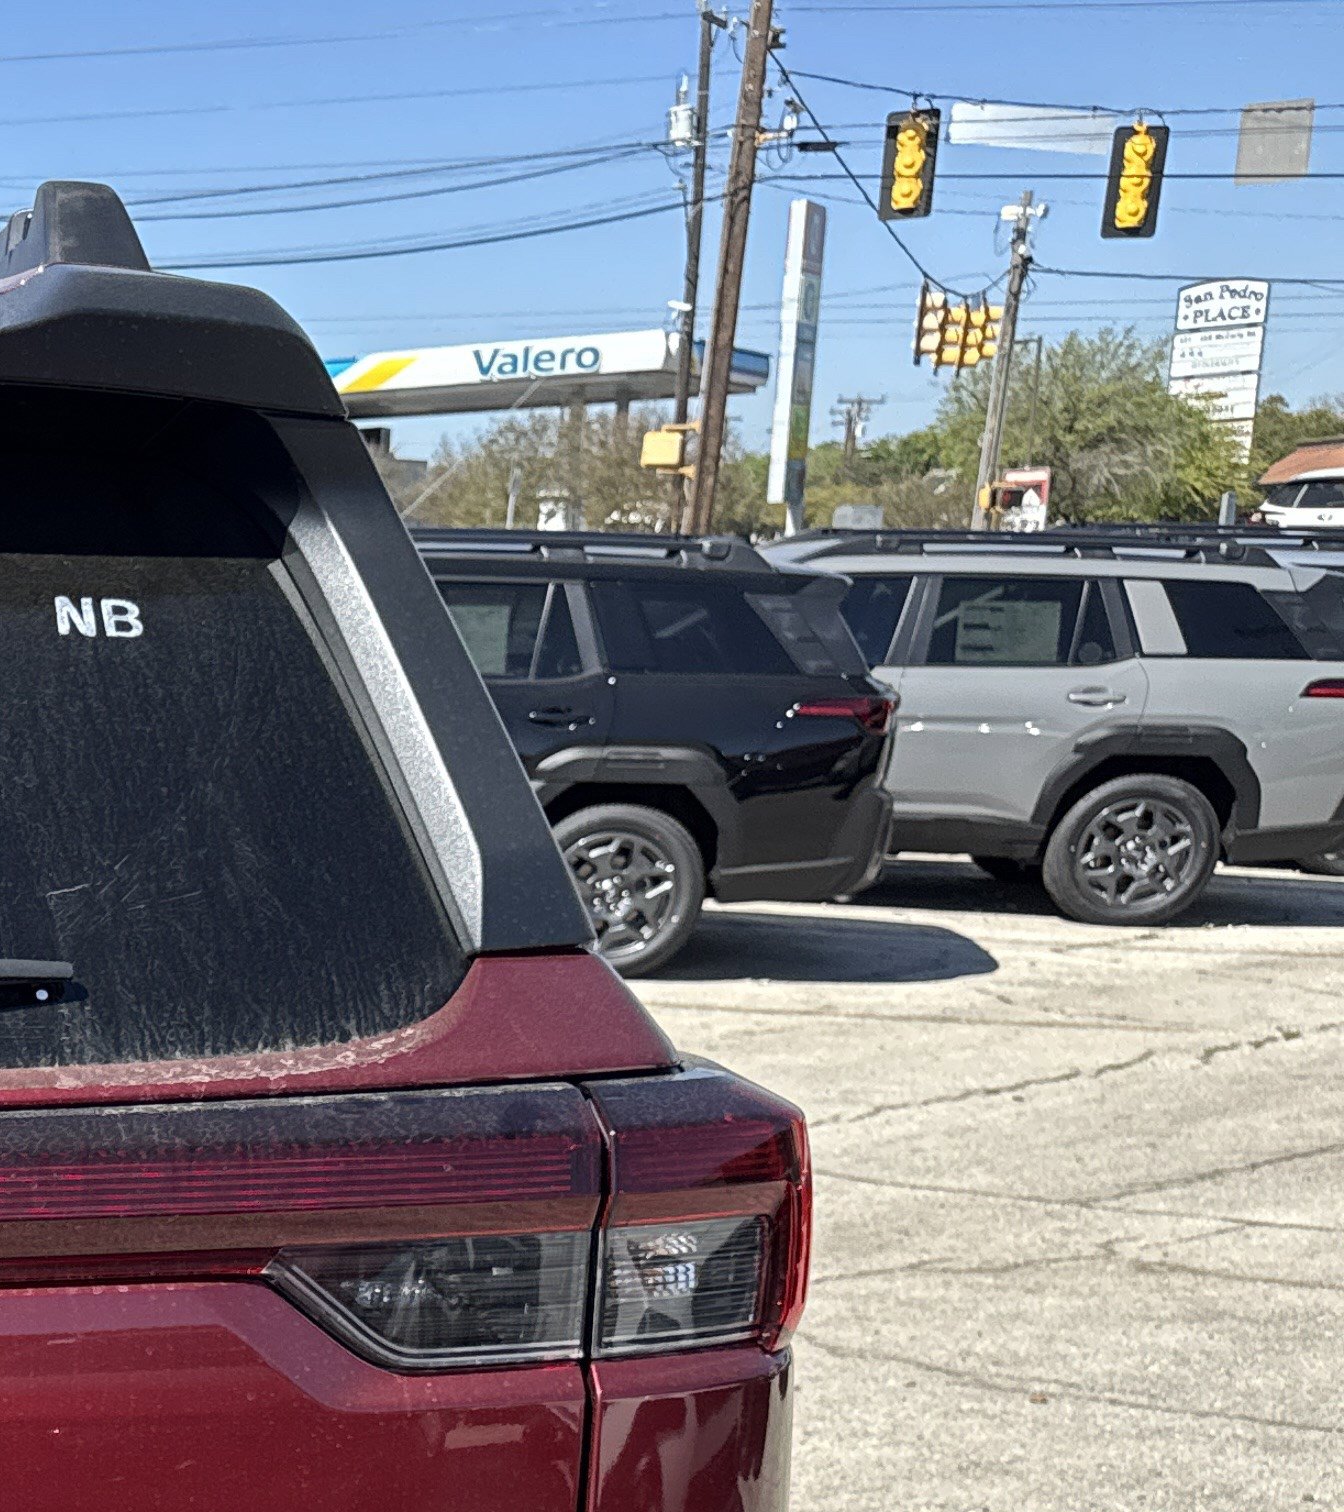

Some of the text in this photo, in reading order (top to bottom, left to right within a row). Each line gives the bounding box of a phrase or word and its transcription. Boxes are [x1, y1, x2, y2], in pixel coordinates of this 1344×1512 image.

[1219, 284, 1265, 302] Pedro
[1193, 305, 1251, 324] PLACE
[472, 346, 600, 376] Valero
[54, 595, 144, 638] NB
